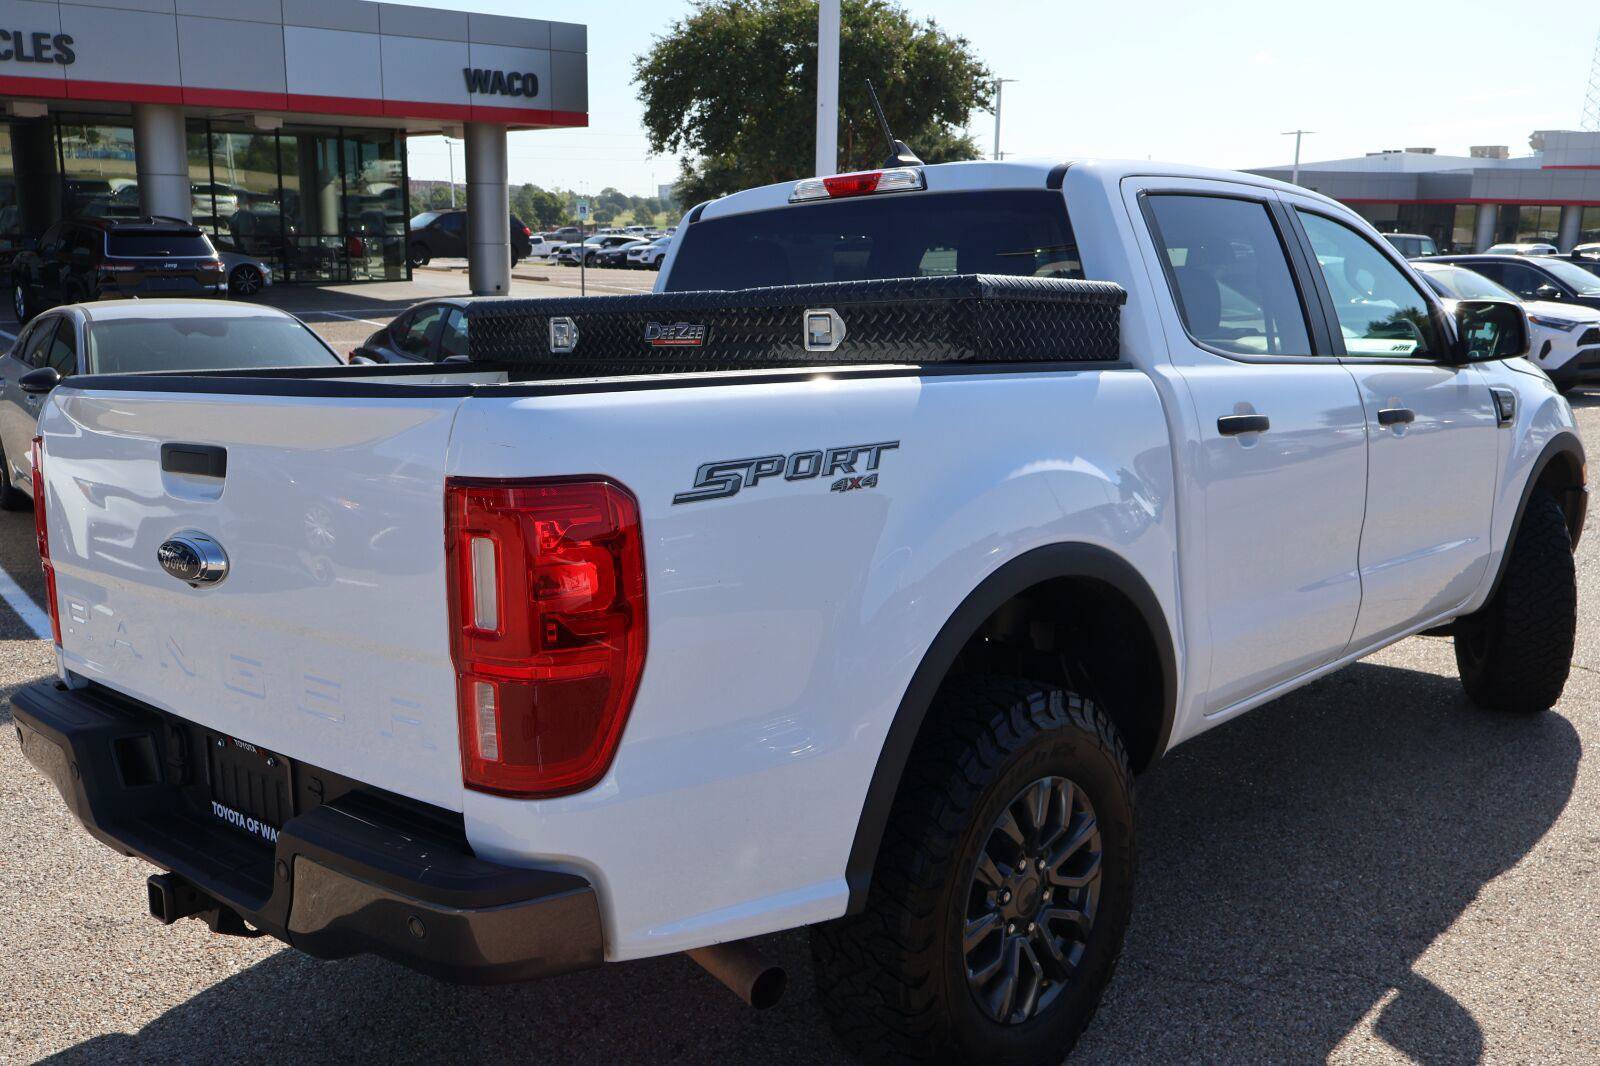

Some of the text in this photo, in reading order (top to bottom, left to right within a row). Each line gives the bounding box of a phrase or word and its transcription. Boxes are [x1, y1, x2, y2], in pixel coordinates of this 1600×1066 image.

[463, 67, 539, 98] WACO
[672, 441, 900, 504] SPORT
[234, 739, 257, 754] TOYOTA
[212, 801, 246, 829] TOYOTA
[247, 818, 260, 834] OF
